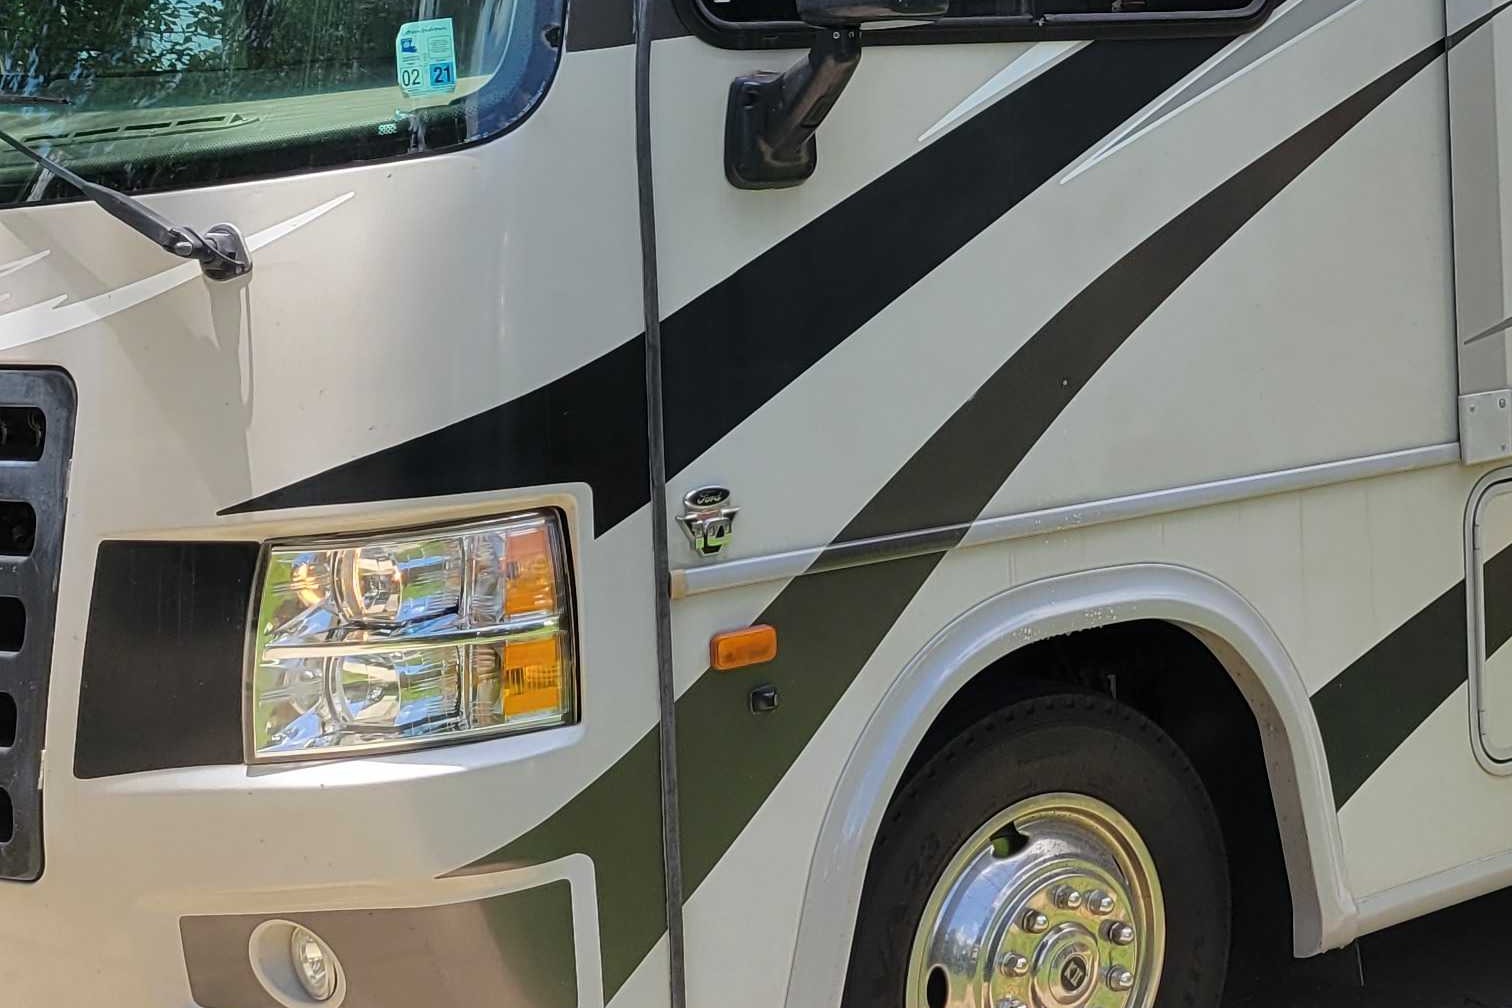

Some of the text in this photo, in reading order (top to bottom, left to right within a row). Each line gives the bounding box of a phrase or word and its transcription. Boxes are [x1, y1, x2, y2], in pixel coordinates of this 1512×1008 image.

[402, 66, 452, 87] 02 21
[696, 494, 722, 505] Ford
